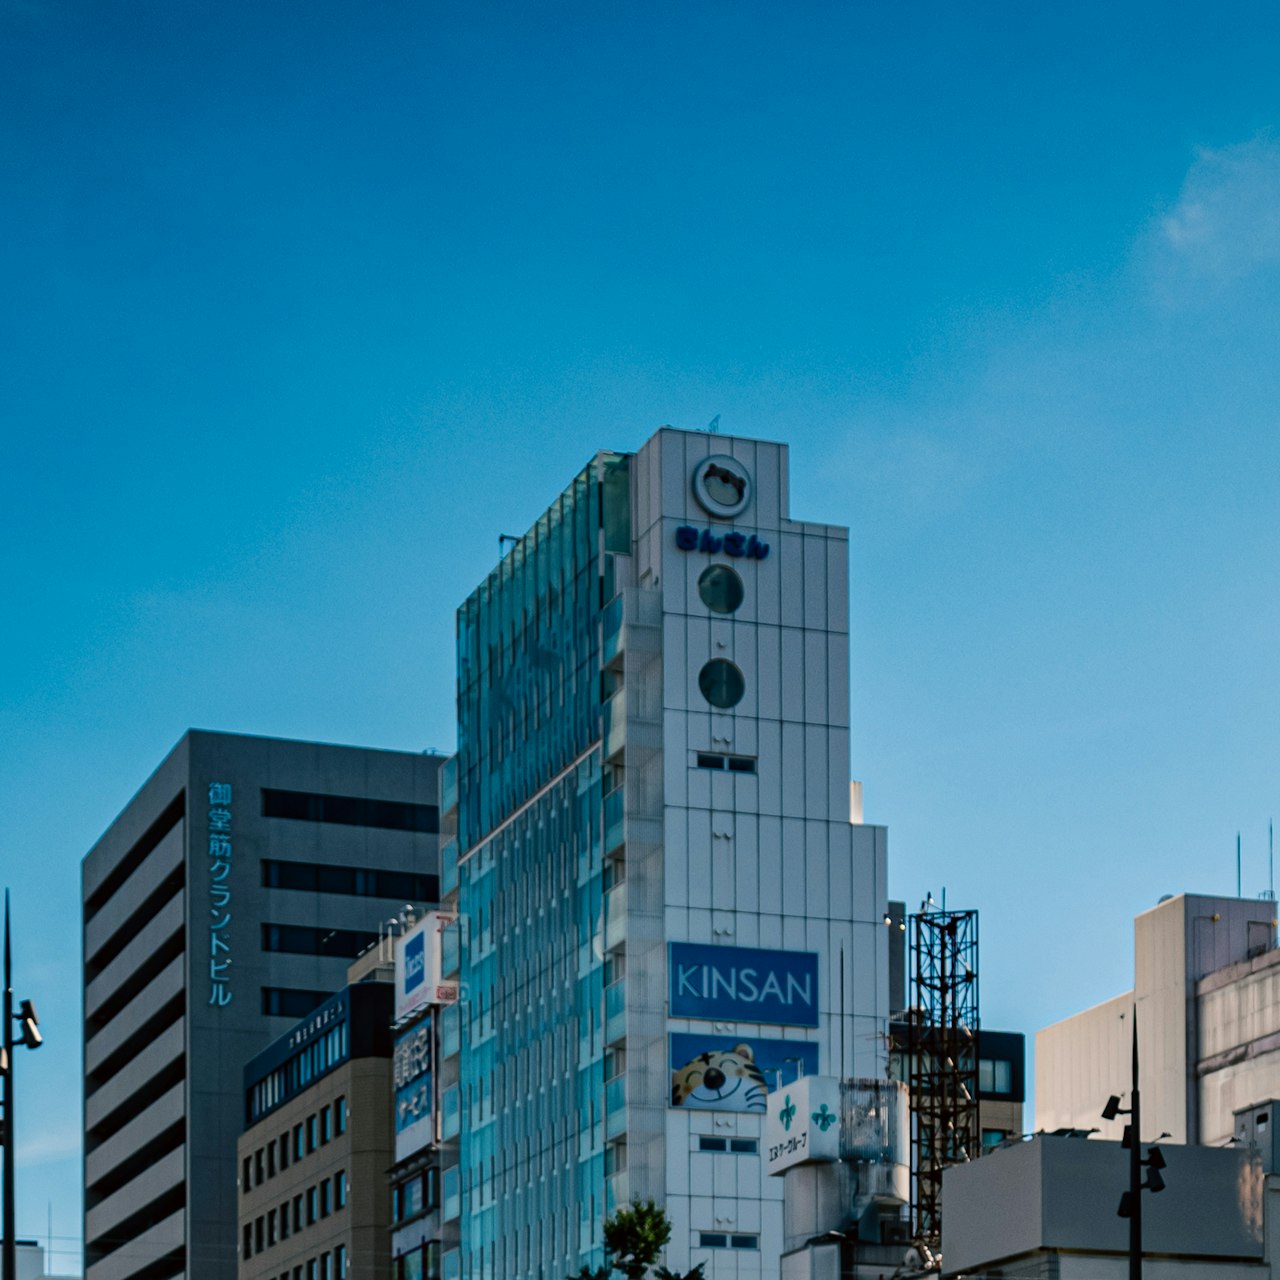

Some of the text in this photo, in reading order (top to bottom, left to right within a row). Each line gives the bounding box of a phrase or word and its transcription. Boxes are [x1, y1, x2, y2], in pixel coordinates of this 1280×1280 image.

[208, 781, 232, 1006] 御堂筋グランドビル
[678, 963, 811, 1007] KINSAN
